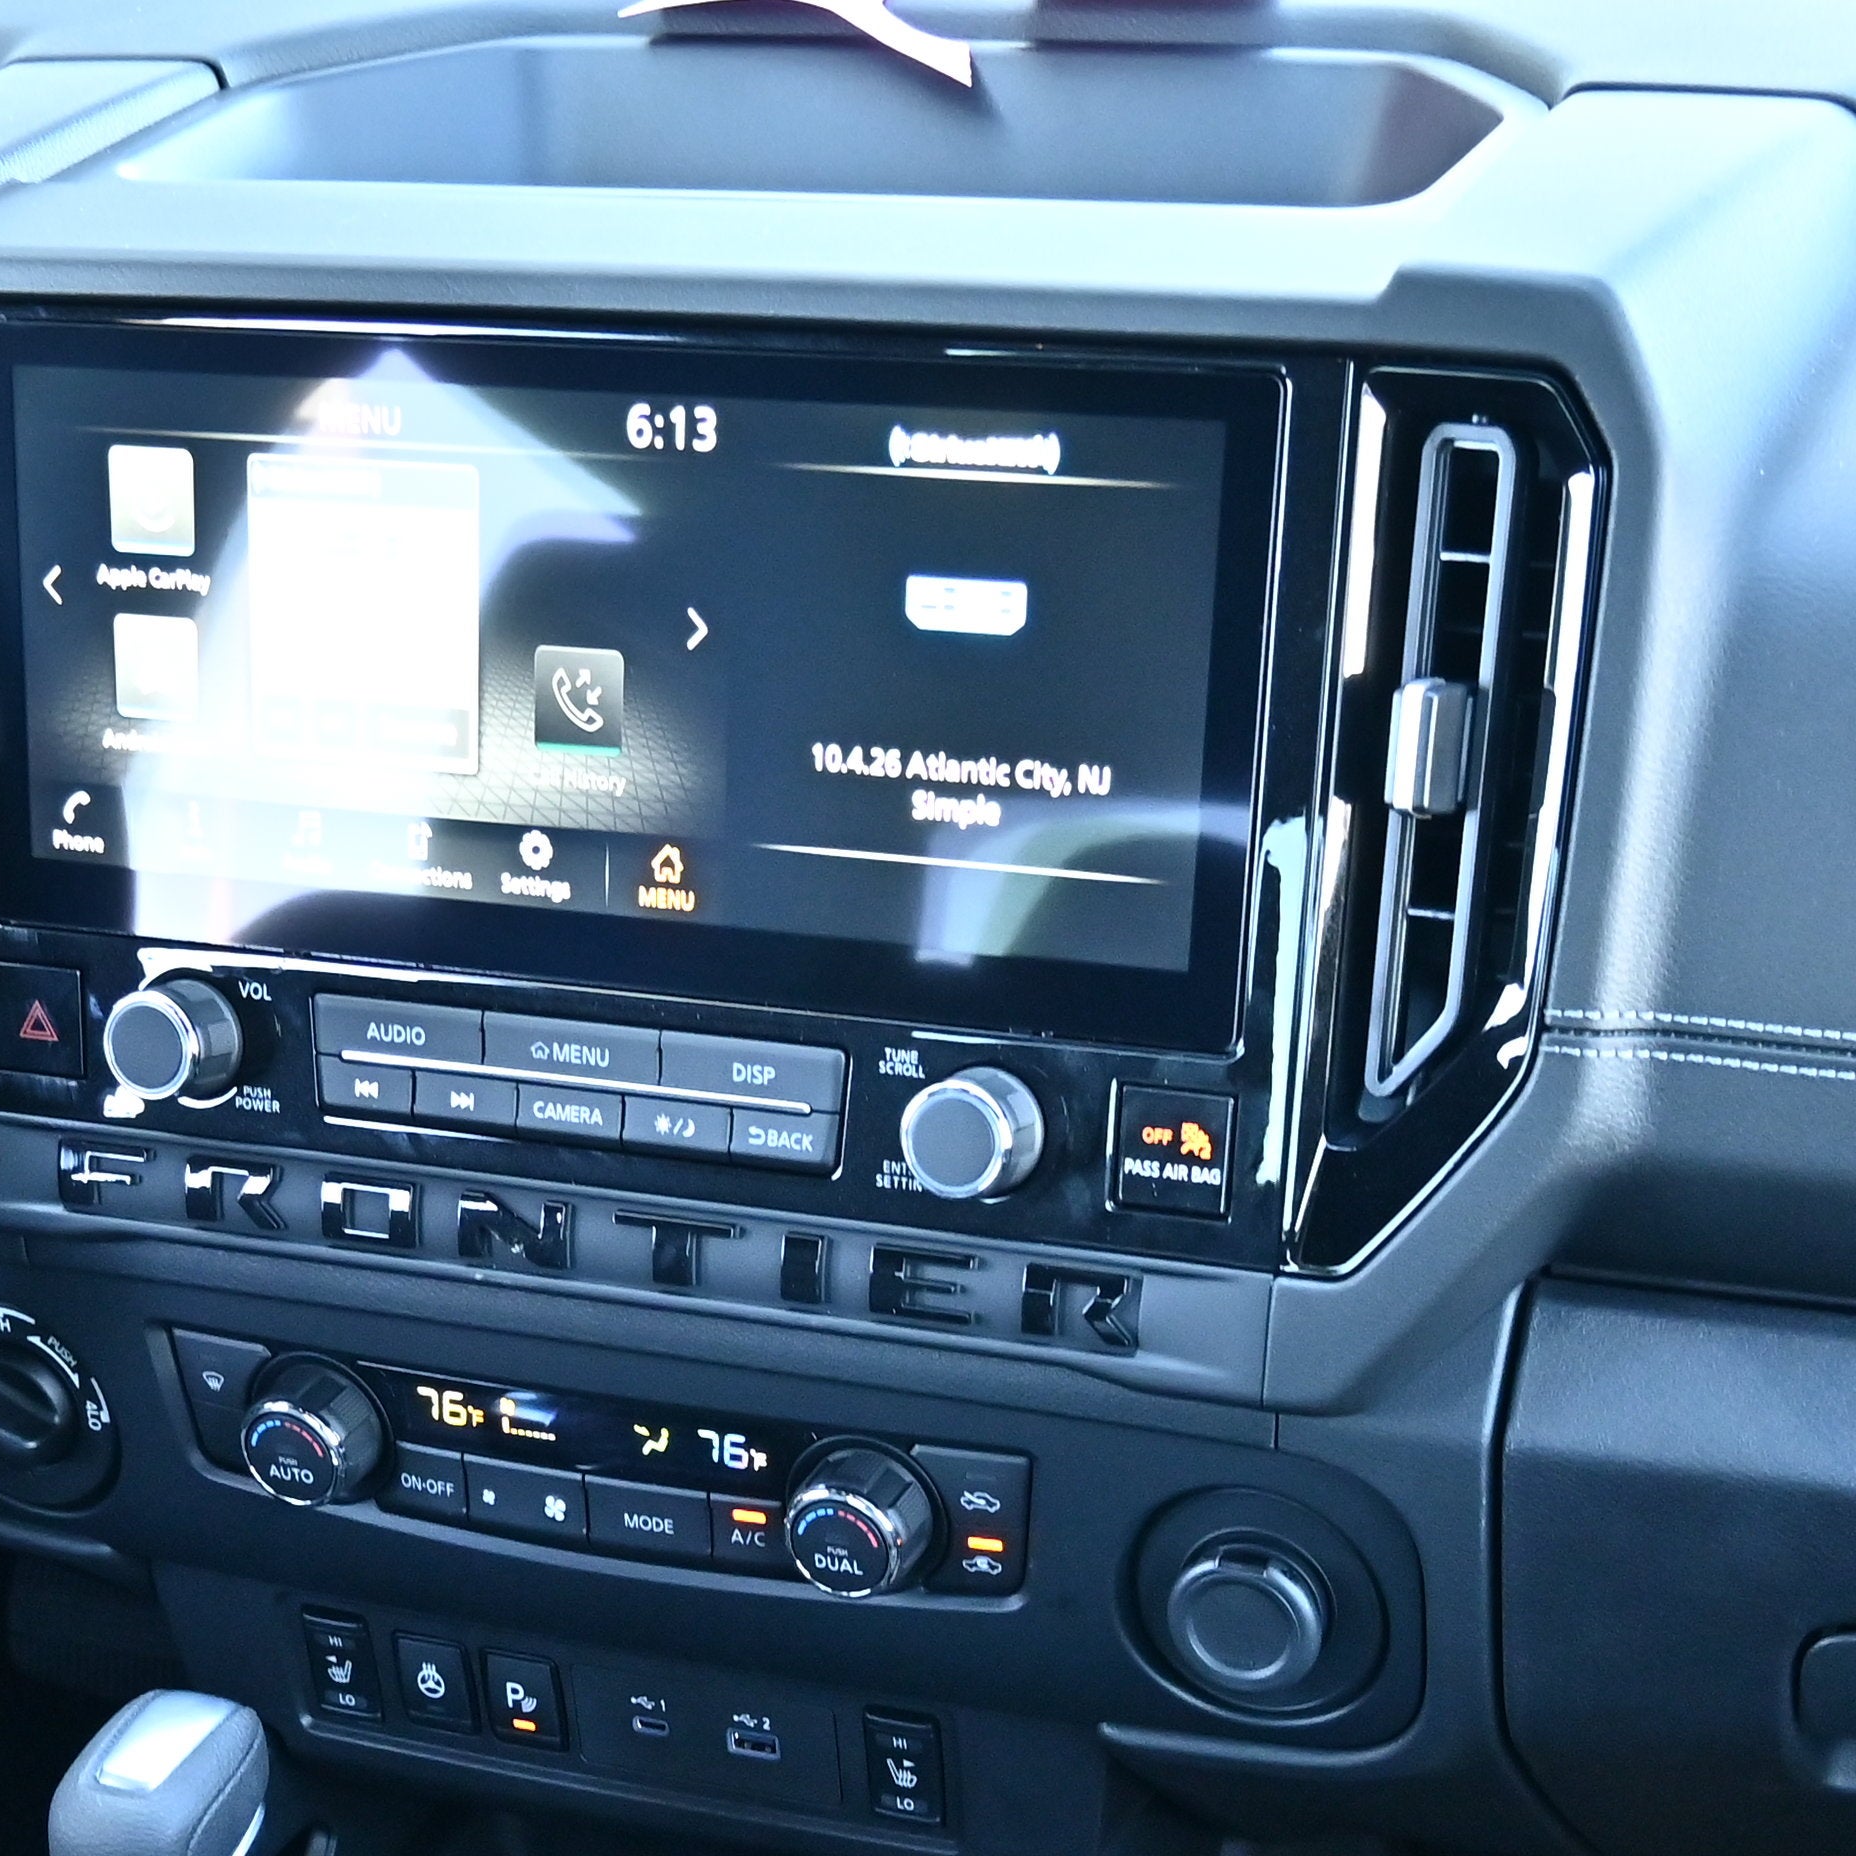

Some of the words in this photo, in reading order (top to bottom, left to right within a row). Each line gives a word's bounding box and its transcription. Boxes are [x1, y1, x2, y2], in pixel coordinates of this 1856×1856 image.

[626, 402, 718, 453] 6:13
[97, 563, 147, 591] Apple
[811, 742, 902, 778] 10.4.26
[905, 750, 1011, 788] Atlantic
[1014, 758, 1072, 798] City,
[1077, 763, 1112, 796] NJ
[911, 788, 1002, 830] Simple
[52, 828, 105, 855] Phone
[500, 872, 572, 904] Settings
[638, 885, 695, 913] MENU
[238, 981, 272, 1001] VOL
[367, 1021, 426, 1046] AUDIO
[553, 1041, 609, 1068] MENU
[884, 1047, 919, 1064] TUNE
[732, 1062, 776, 1086] DISP
[878, 1060, 925, 1080] SCROLL
[243, 1085, 272, 1100] PUSH
[235, 1097, 281, 1114] POWER
[533, 1101, 603, 1126] CAMERA
[767, 1131, 814, 1152] BACK
[1142, 1126, 1173, 1146] OFF
[1124, 1156, 1160, 1179] PASS
[1162, 1162, 1189, 1182] AIR
[1190, 1165, 1222, 1186] BAG
[875, 1173, 923, 1193] SETTIN
[58, 1138, 1143, 1356] FRONTIER
[47, 1335, 78, 1367] PUSH
[85, 1400, 102, 1432] 4LO
[269, 1464, 314, 1485] AUTO
[623, 1512, 675, 1535] MODE
[731, 1528, 766, 1547] A/C
[814, 1552, 864, 1576] DUAL
[328, 1634, 343, 1648] HI
[339, 1692, 356, 1706] LO
[505, 1681, 525, 1709] P
[659, 1698, 667, 1713] 1
[761, 1716, 771, 1731] 2
[893, 1736, 908, 1750] HI
[896, 1796, 914, 1811] LO
